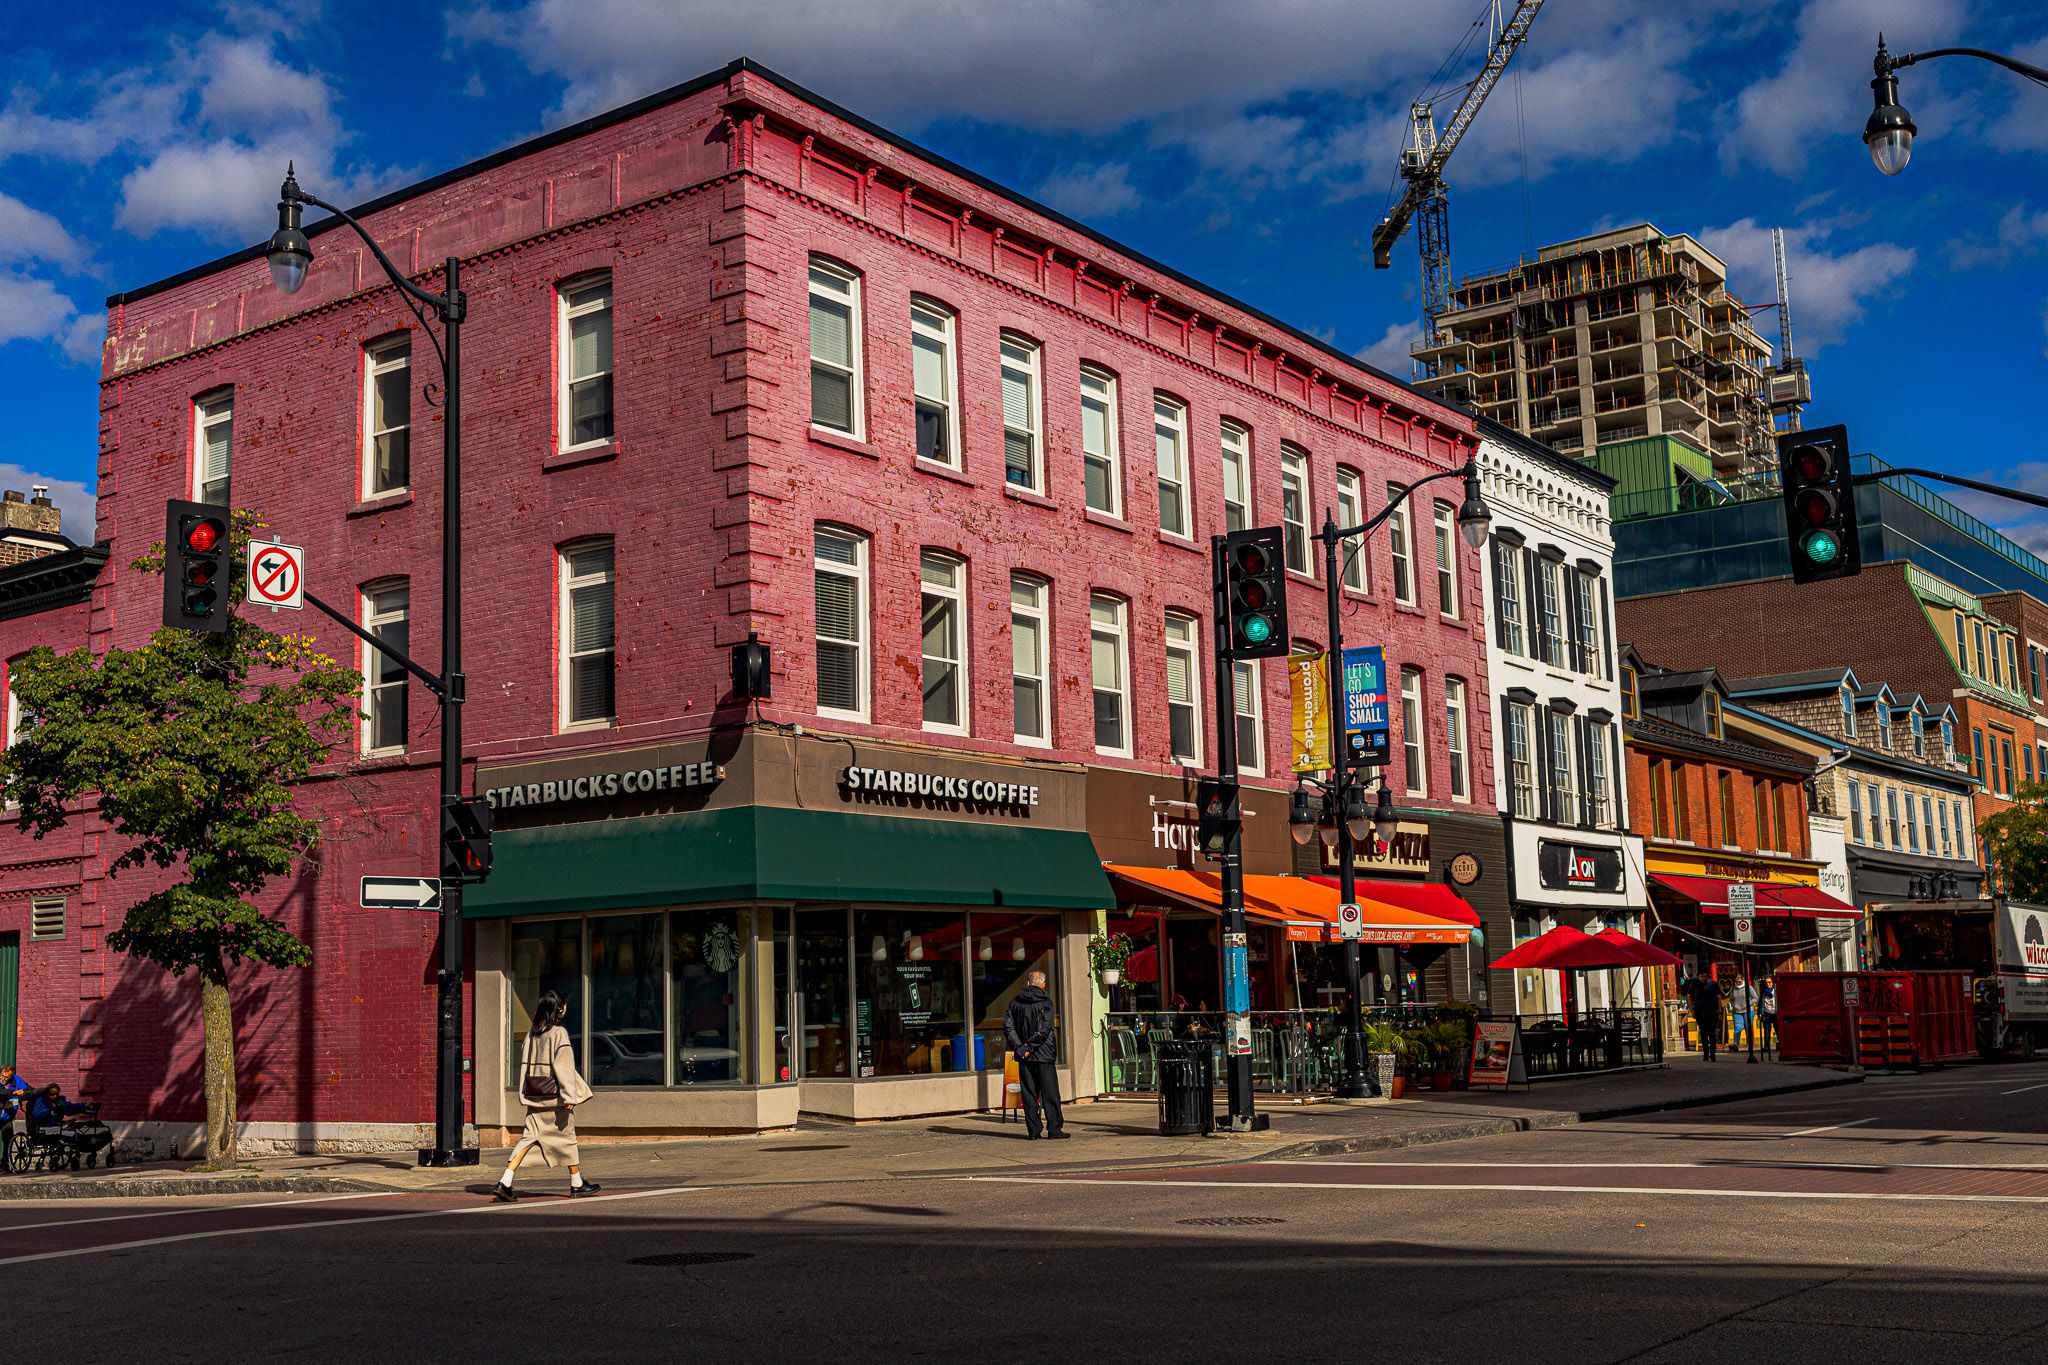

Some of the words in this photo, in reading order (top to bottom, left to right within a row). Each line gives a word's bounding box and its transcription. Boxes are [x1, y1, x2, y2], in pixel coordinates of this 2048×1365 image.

[1347, 663, 1371, 680] LET'S
[1348, 678, 1362, 694] GO
[1299, 661, 1317, 749] promenade
[1348, 693, 1377, 709] SHOP
[1349, 708, 1385, 725] SMALL.
[485, 773, 618, 809] STARBUCKS
[622, 761, 714, 793] COFFEE
[848, 766, 969, 799] STARBUCKS
[971, 779, 1039, 806] COFFEE
[1151, 811, 1200, 865] Harp
[1454, 864, 1475, 873] SCORE
